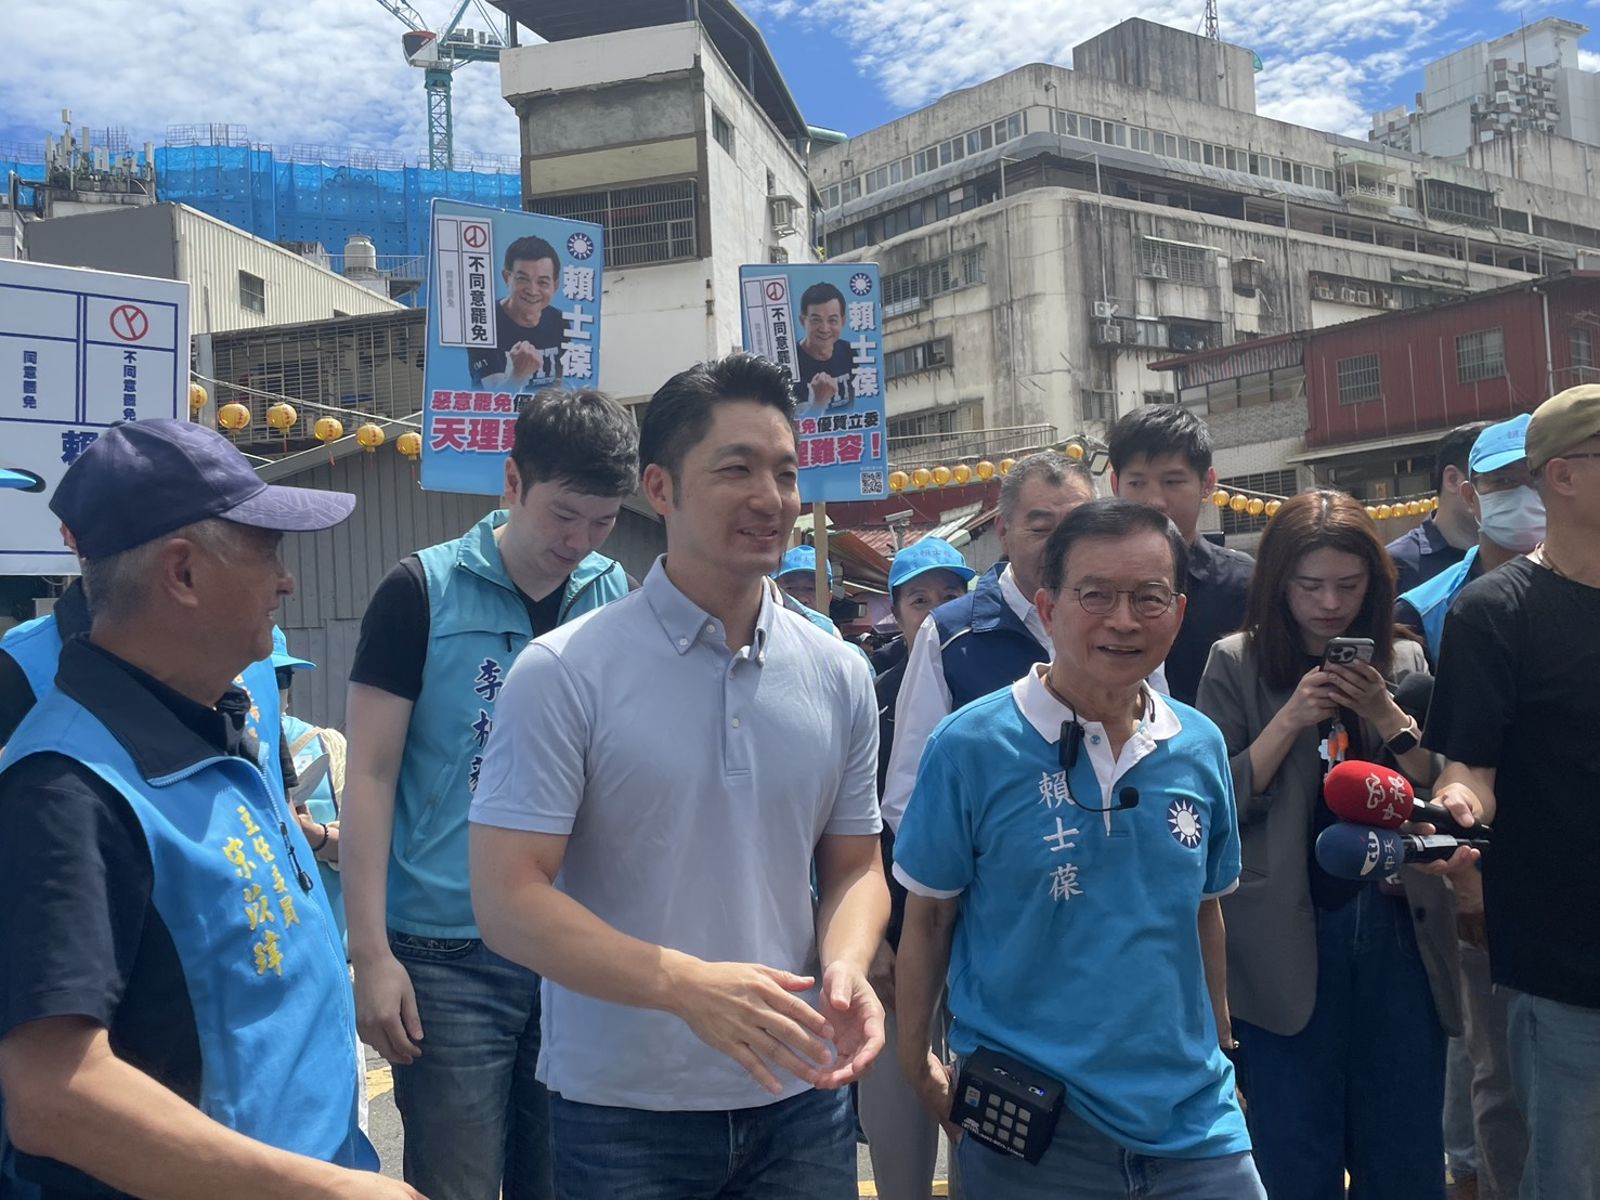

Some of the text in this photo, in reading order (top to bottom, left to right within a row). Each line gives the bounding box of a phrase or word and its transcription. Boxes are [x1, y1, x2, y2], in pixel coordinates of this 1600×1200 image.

[468, 256, 488, 342] 不同意罷免
[560, 265, 595, 379] 賴士葆
[23, 350, 37, 409] 同意罷免
[123, 350, 137, 421] 不同意罷免
[849, 301, 879, 398] 賴士葆
[797, 411, 880, 436] 免優質立委
[1037, 769, 1083, 901] 賴士葆
[1383, 838, 1395, 870] 中天
